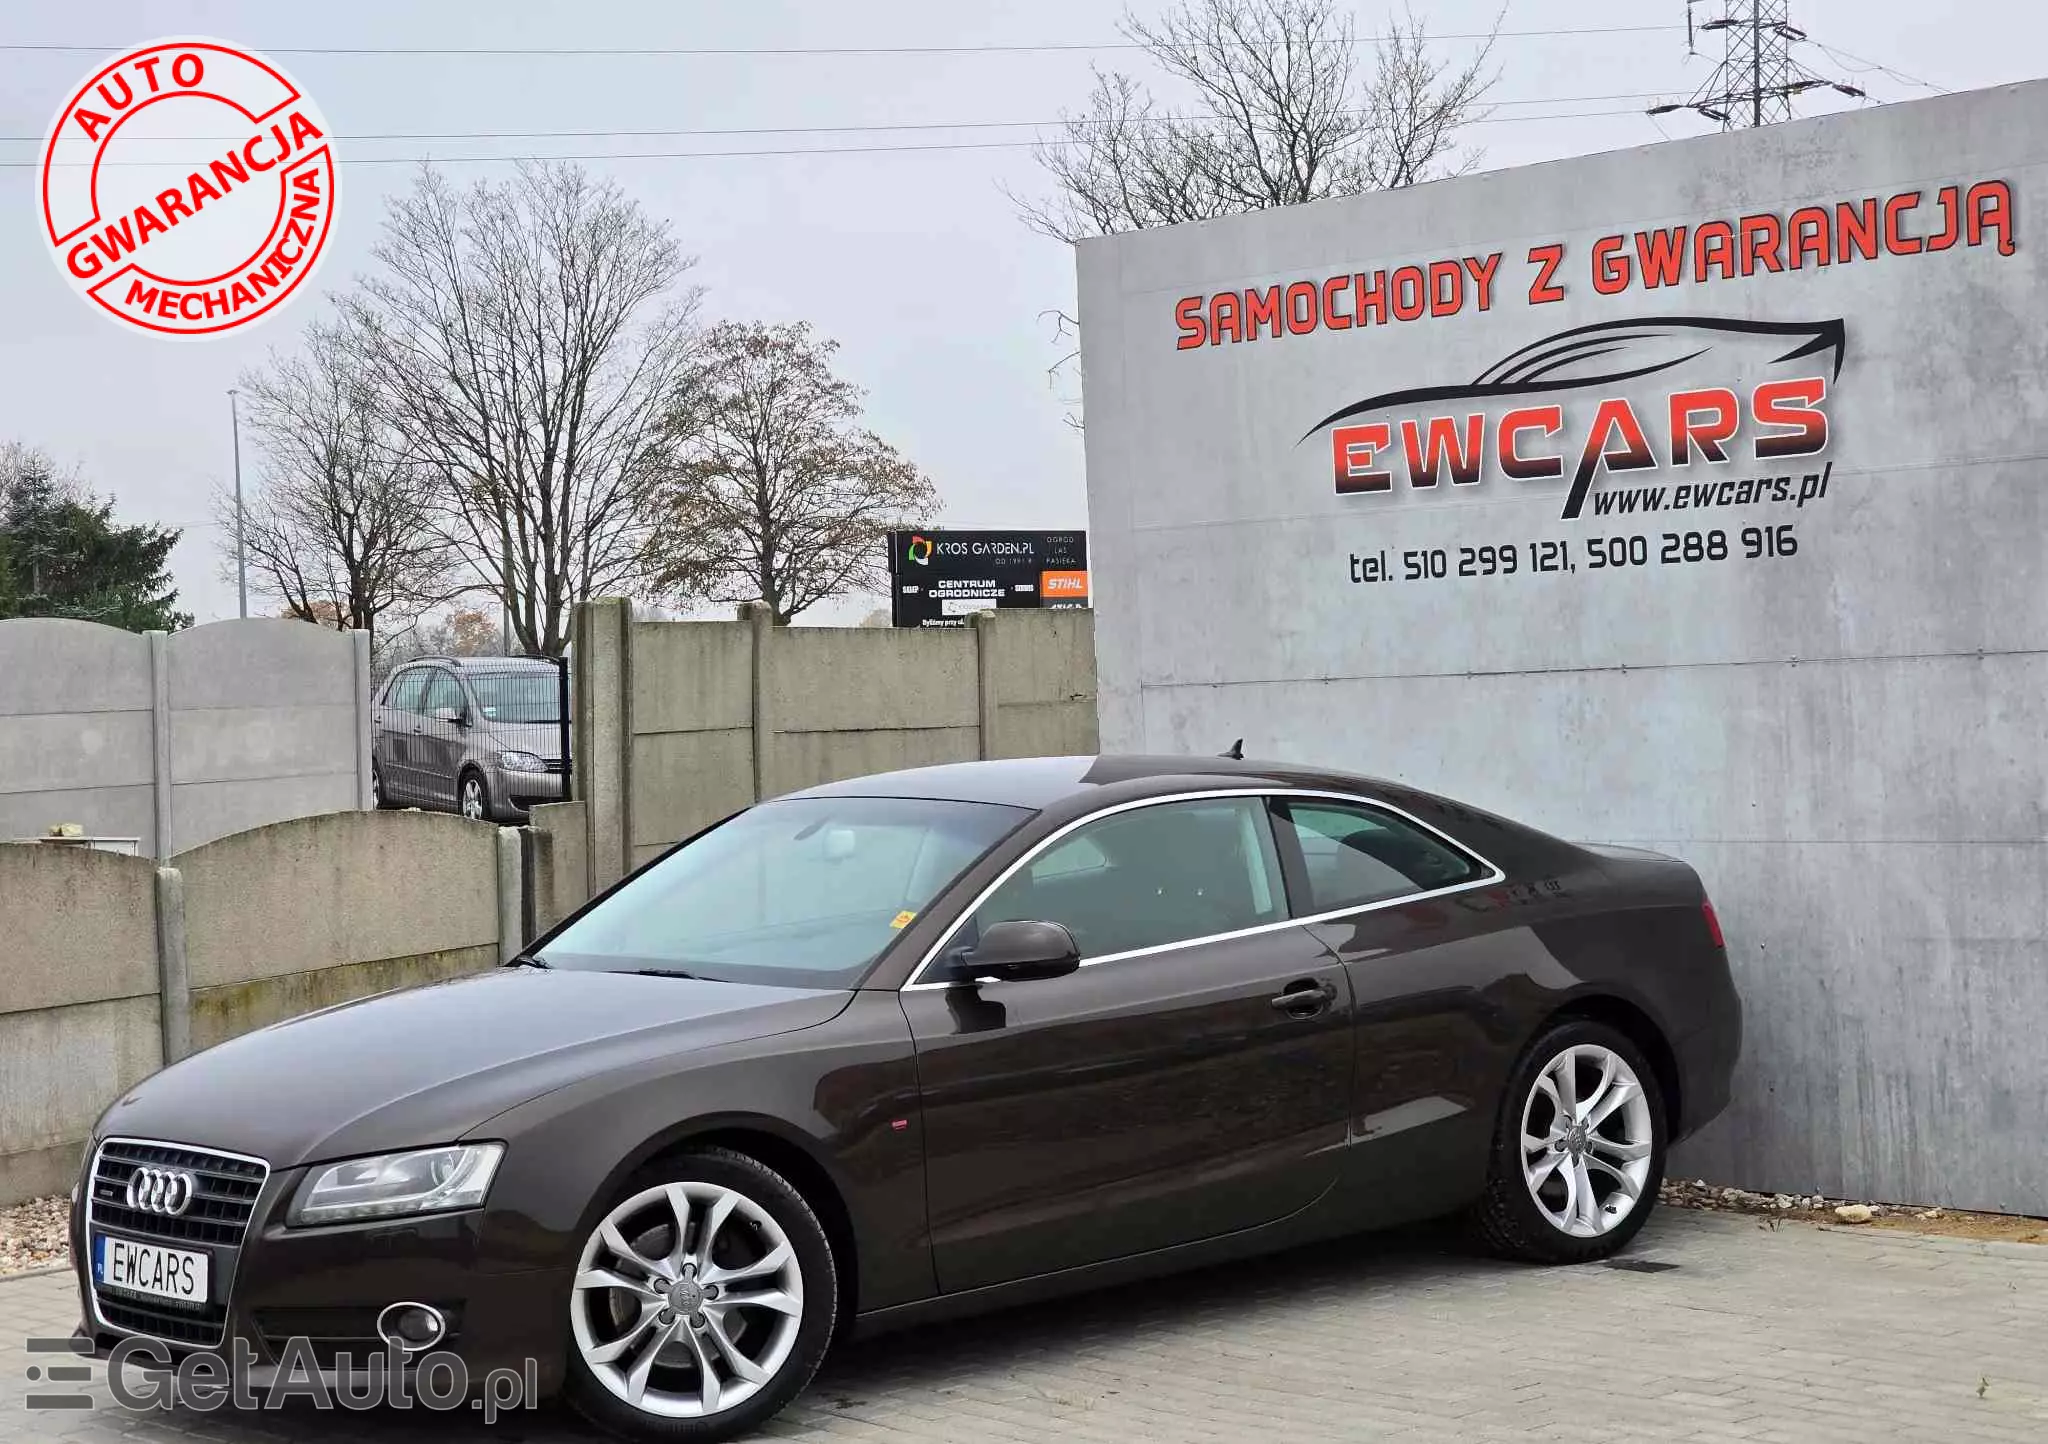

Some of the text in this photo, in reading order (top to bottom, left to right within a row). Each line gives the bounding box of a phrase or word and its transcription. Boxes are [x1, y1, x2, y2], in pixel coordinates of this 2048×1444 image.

[1176, 180, 2016, 351] SAMOCHODY Z GWARANCJĄ
[1331, 376, 1829, 520] EWCARS
[1594, 462, 1833, 516] www.ewcars.pl
[937, 542, 1034, 555] KROS GARDEN.PL
[1349, 525, 1799, 584] tel. 510 299 121, 500 288 916
[928, 589, 1006, 598] OGRODNICZE
[938, 580, 996, 588] CENTRUM
[1047, 577, 1084, 590] STIHL
[113, 1242, 195, 1295] EWCARS
